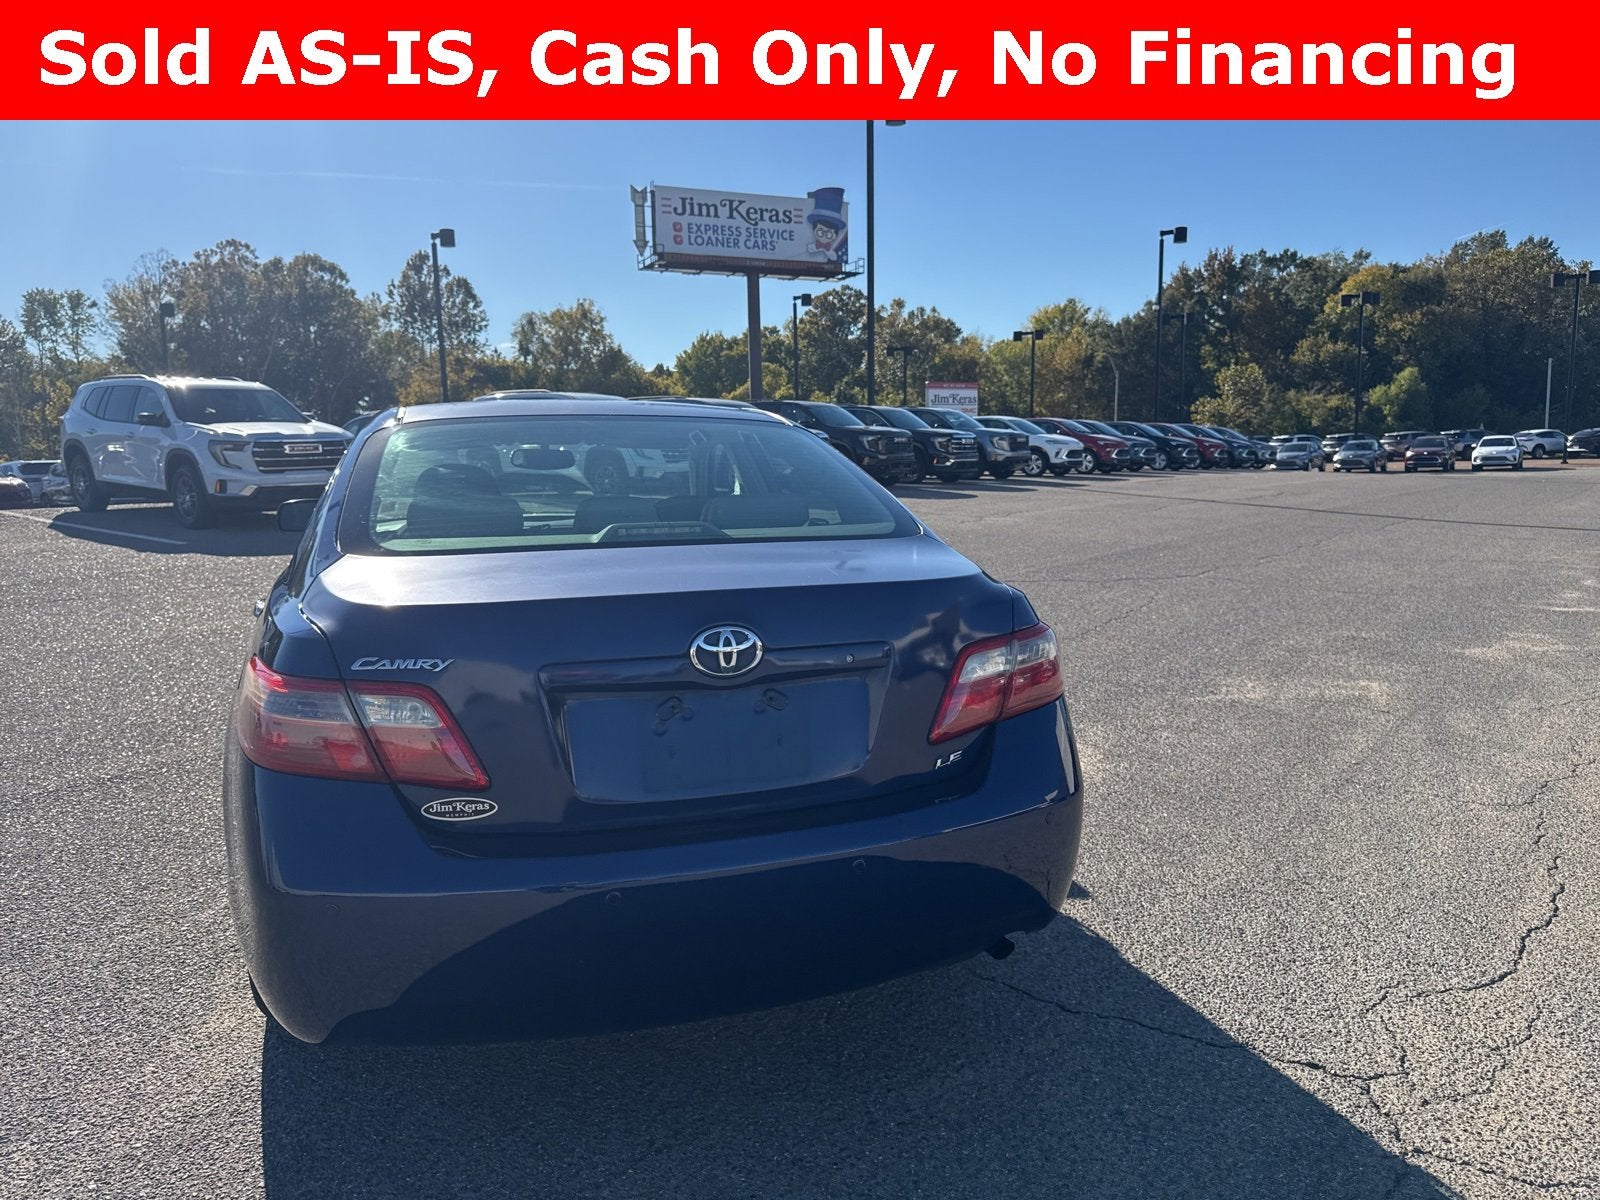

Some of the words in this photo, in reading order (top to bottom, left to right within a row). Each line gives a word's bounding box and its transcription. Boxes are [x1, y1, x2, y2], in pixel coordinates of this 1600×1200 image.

[673, 196, 720, 218] Jim
[720, 198, 793, 227] Keras
[687, 222, 742, 238] EXPRESS
[745, 226, 795, 242] SERVICE
[688, 234, 740, 249] LOANER
[931, 394, 950, 404] Jim
[949, 393, 977, 405] Keras
[351, 657, 455, 672] CAMRY
[935, 750, 962, 770] LE
[429, 803, 453, 813] Jim
[452, 801, 490, 813] Keras
